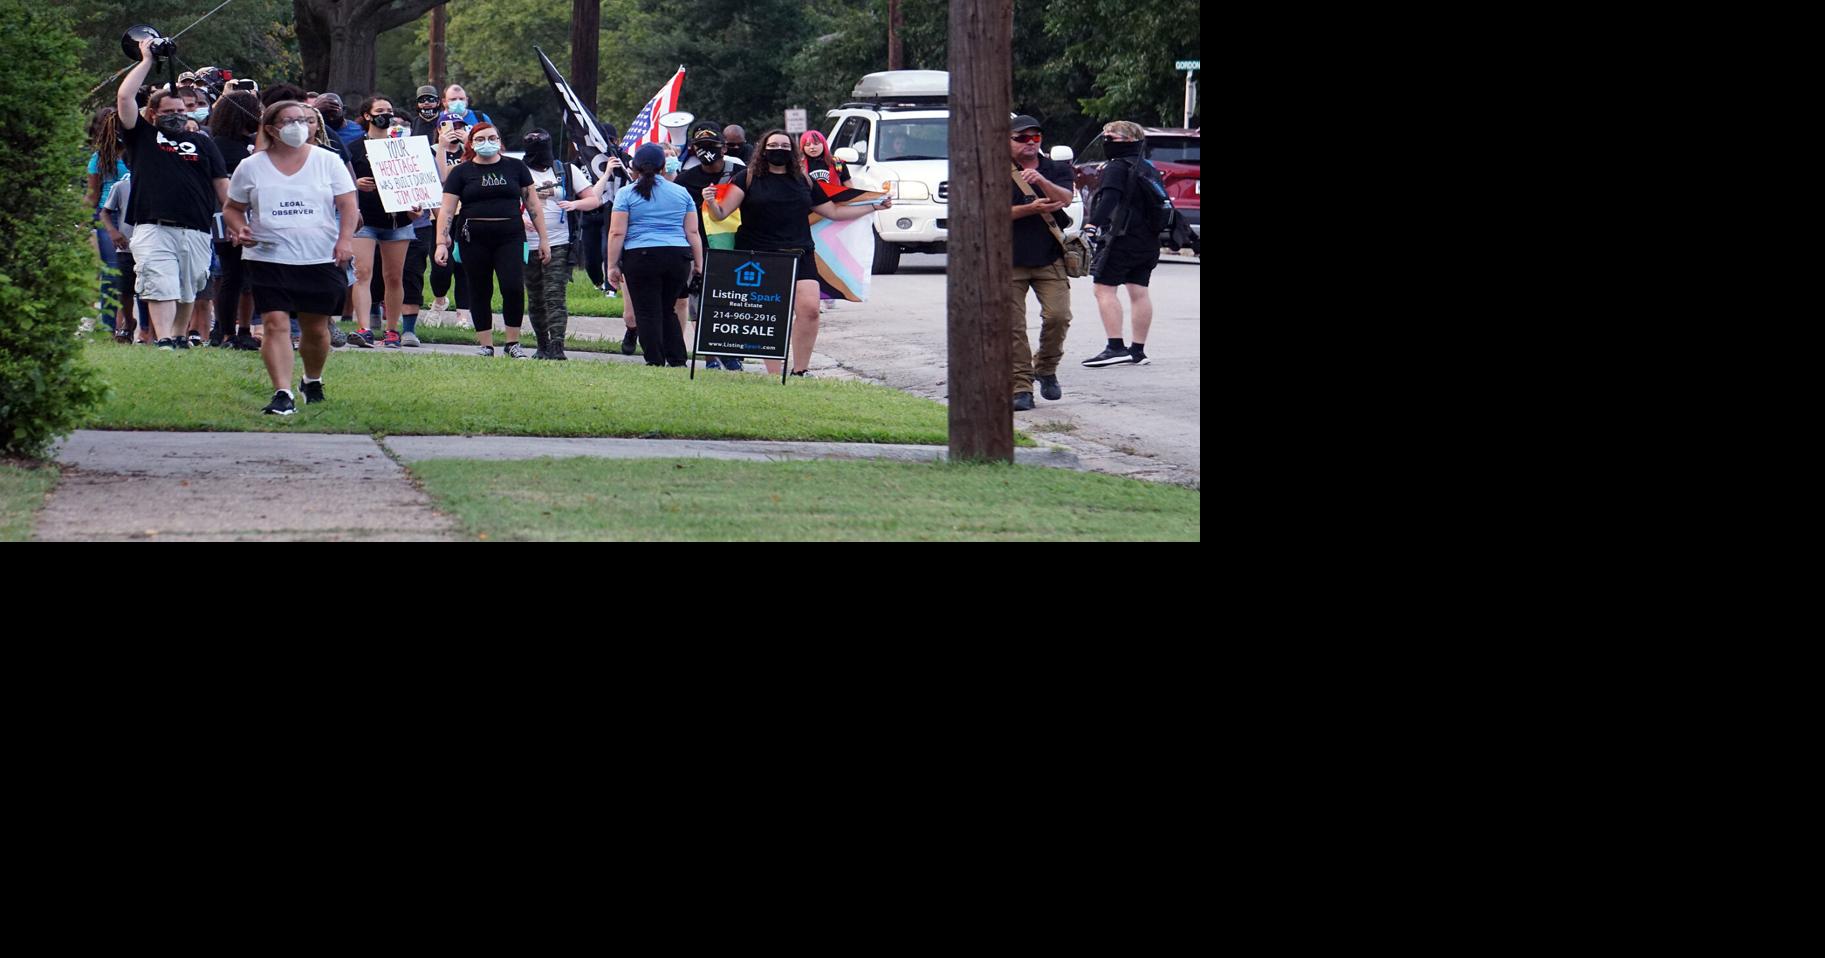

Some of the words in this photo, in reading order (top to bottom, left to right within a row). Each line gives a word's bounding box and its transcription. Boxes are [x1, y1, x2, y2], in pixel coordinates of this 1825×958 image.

[384, 139, 410, 159] YOUR
[394, 190, 411, 205] JIM
[411, 187, 432, 203] CROW
[712, 289, 748, 302] Listing
[750, 291, 781, 303] Spark
[713, 310, 777, 322] 214-960-2916
[712, 323, 739, 334] FOR
[741, 325, 775, 337] SALE
